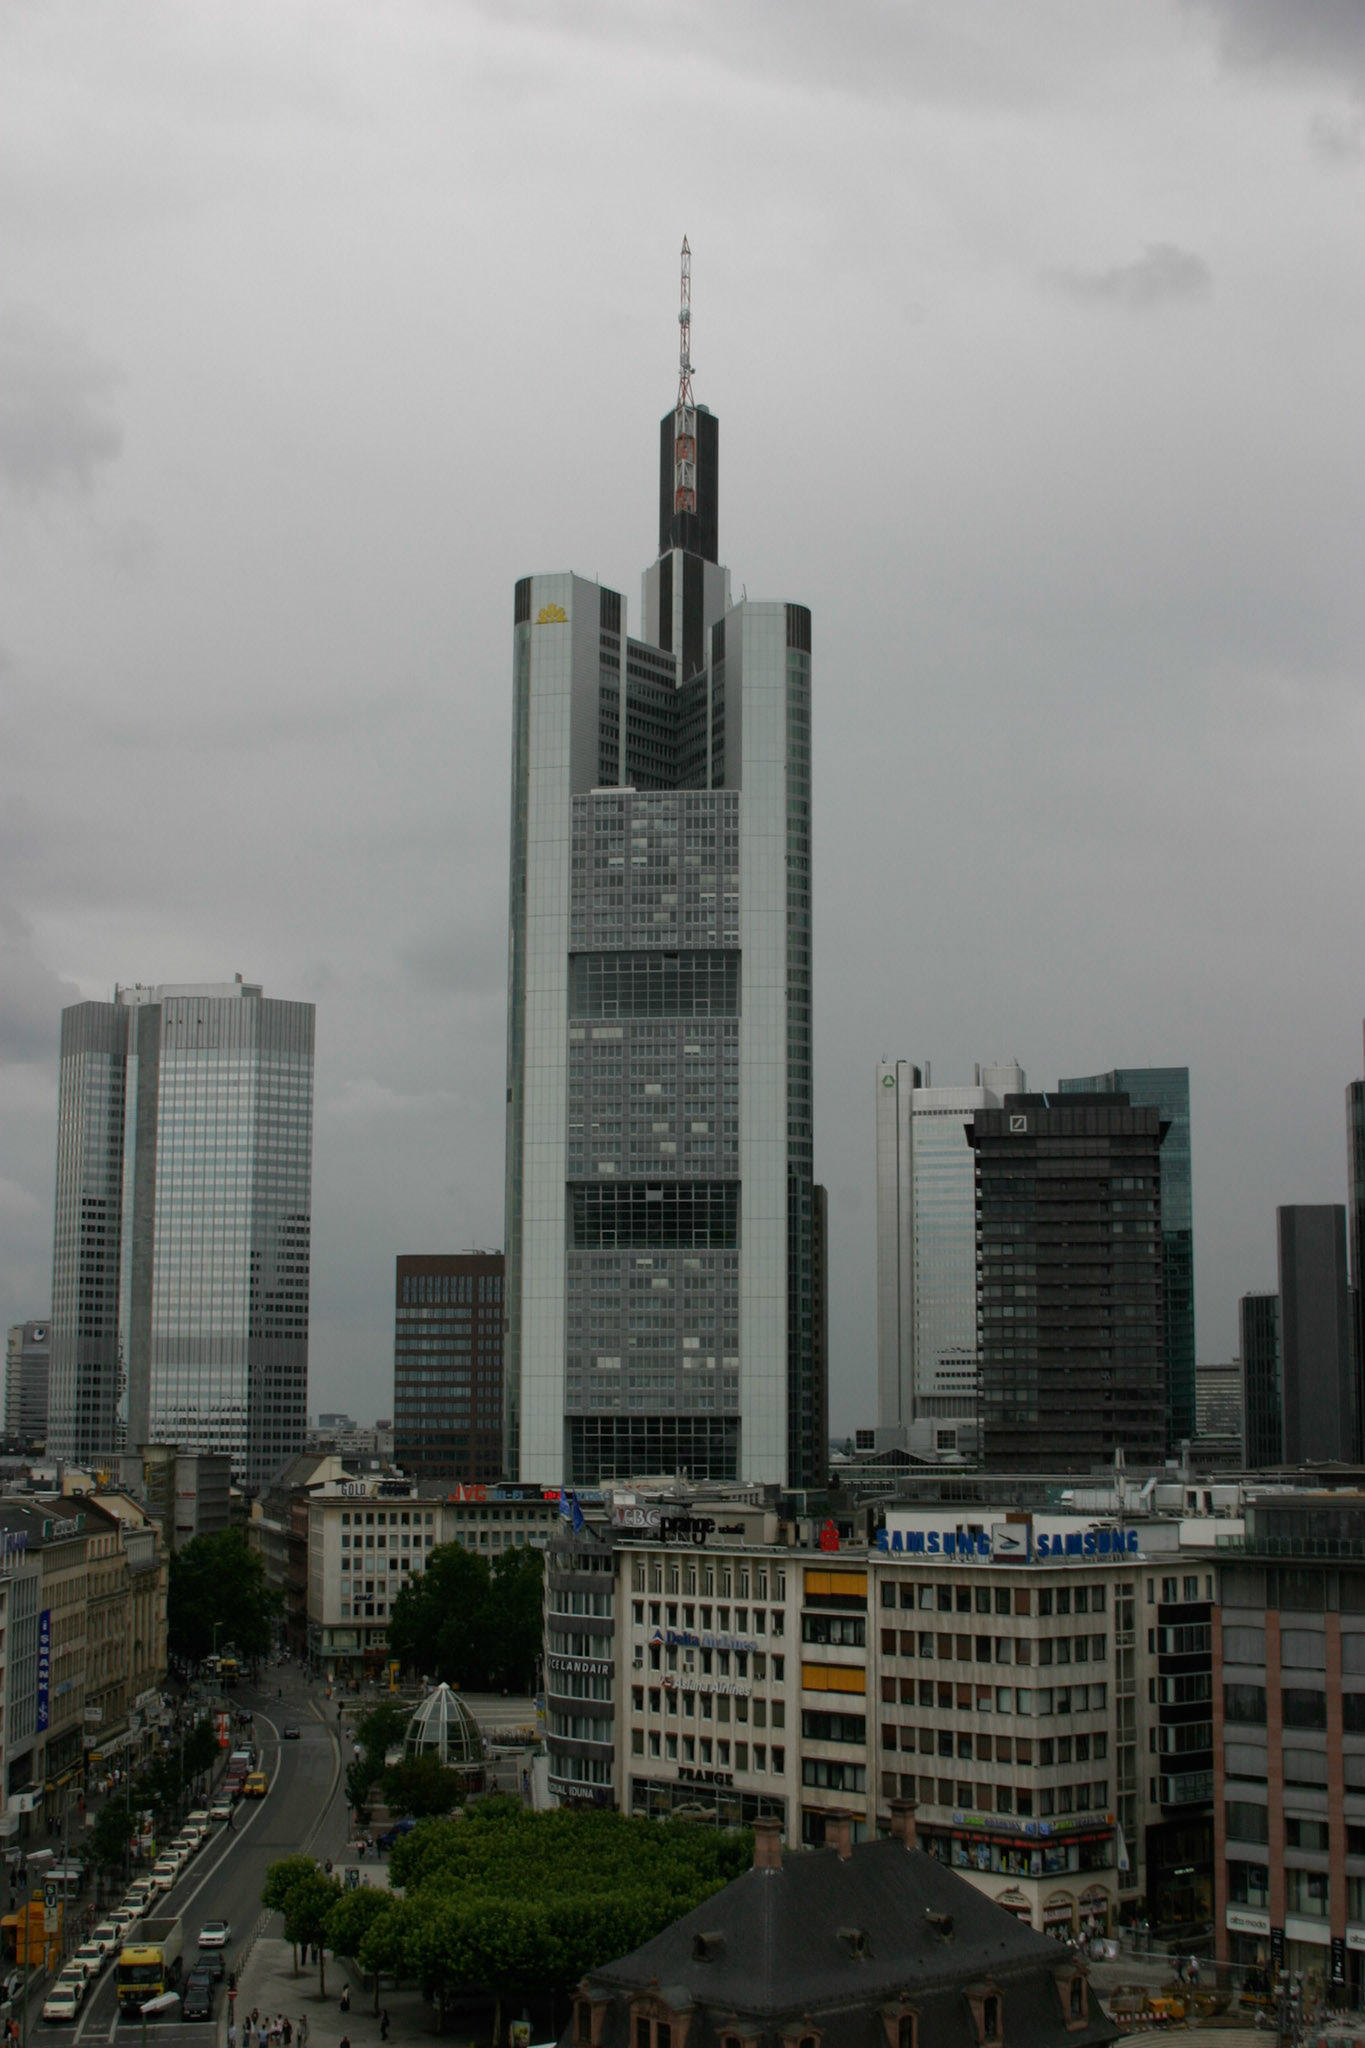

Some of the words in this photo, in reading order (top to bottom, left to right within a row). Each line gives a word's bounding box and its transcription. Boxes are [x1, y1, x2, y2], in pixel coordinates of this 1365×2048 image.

[341, 1483, 366, 1496] GOLD
[449, 1484, 487, 1502] JVC
[661, 1516, 715, 1545] prange
[876, 1527, 991, 1556] SAMSUNG
[1037, 1530, 1139, 1557] SAMSUNG
[666, 1630, 700, 1647] Delta
[548, 1658, 609, 1675] ICELANDAIR
[673, 1677, 709, 1692] Asiana
[711, 1682, 752, 1697] Airlines
[678, 1766, 734, 1787] PRANGE
[568, 1786, 594, 1800] IDUNA
